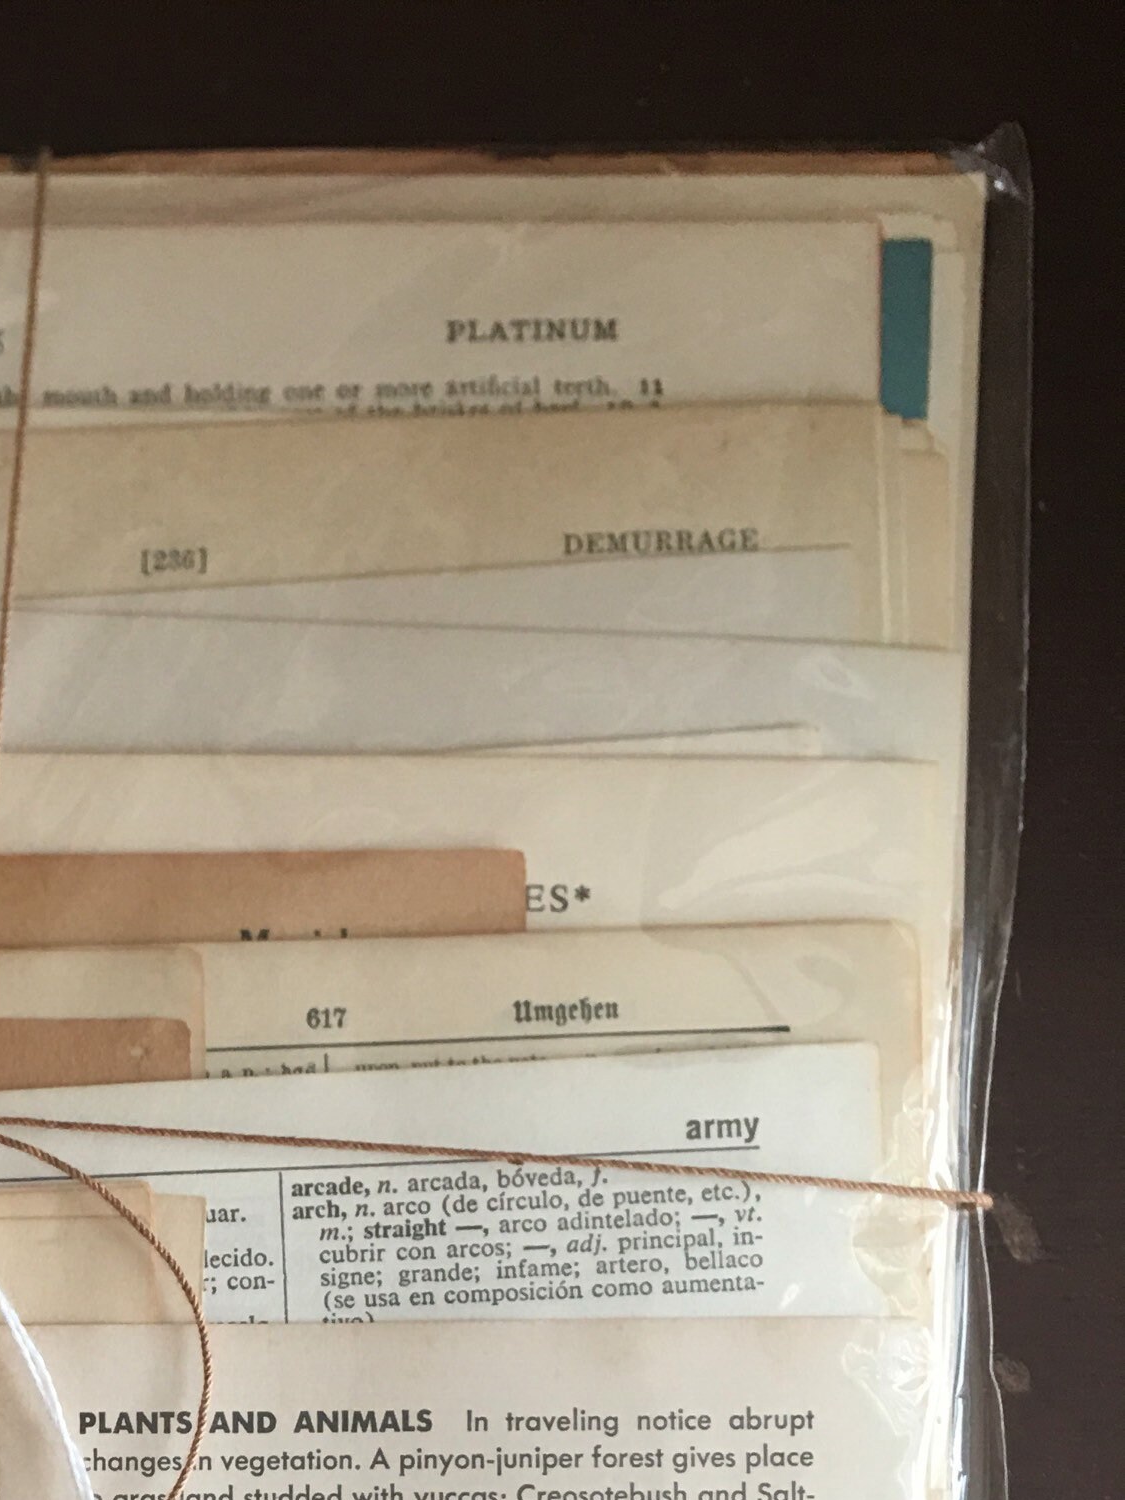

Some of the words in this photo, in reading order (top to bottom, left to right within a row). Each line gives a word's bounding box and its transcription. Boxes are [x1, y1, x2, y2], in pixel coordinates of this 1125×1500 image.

[445, 318, 619, 344] PLATINUM
[445, 374, 545, 398] artificial
[562, 529, 758, 557] DEMURRAGE
[140, 546, 209, 577] [236]
[305, 1007, 348, 1030] 617
[512, 998, 620, 1026] Umgehen
[685, 1117, 760, 1145] army
[290, 1176, 372, 1199] arcade,
[376, 1179, 398, 1195] n.
[407, 1171, 488, 1194] arcada,
[497, 1167, 582, 1191] bóveda,
[291, 1199, 348, 1221] arch,
[355, 1202, 376, 1219] n.
[382, 1200, 433, 1218] arco
[441, 1193, 479, 1218] (de
[483, 1190, 570, 1212] círculo,
[578, 1187, 606, 1209] de
[612, 1187, 694, 1212] puente,
[701, 1181, 761, 1203] etc.),
[318, 1242, 386, 1265] cubrir
[396, 1243, 437, 1261] con
[446, 1235, 512, 1262] arcos;
[521, 1244, 557, 1261] —,
[566, 1232, 608, 1256] adj.
[617, 1227, 723, 1255] principal,
[732, 1225, 763, 1246] in-
[320, 1267, 383, 1290] signe;
[398, 1262, 481, 1288] grande;
[496, 1256, 582, 1282] infame;
[592, 1252, 670, 1275] artero,
[683, 1249, 764, 1271] bellaco
[78, 1411, 193, 1436] PLANTS
[208, 1411, 279, 1435] AND
[292, 1409, 434, 1435] ANIMALS
[465, 1408, 490, 1433] In
[504, 1407, 620, 1439] traveling
[637, 1408, 713, 1432] notice
[728, 1407, 816, 1437] abrupt
[220, 1449, 361, 1477] vegetation.
[369, 1446, 391, 1470] A
[398, 1447, 584, 1477] pinyon-juniper
[591, 1444, 665, 1469] forest
[671, 1445, 737, 1474] gives
[745, 1443, 814, 1474] place
